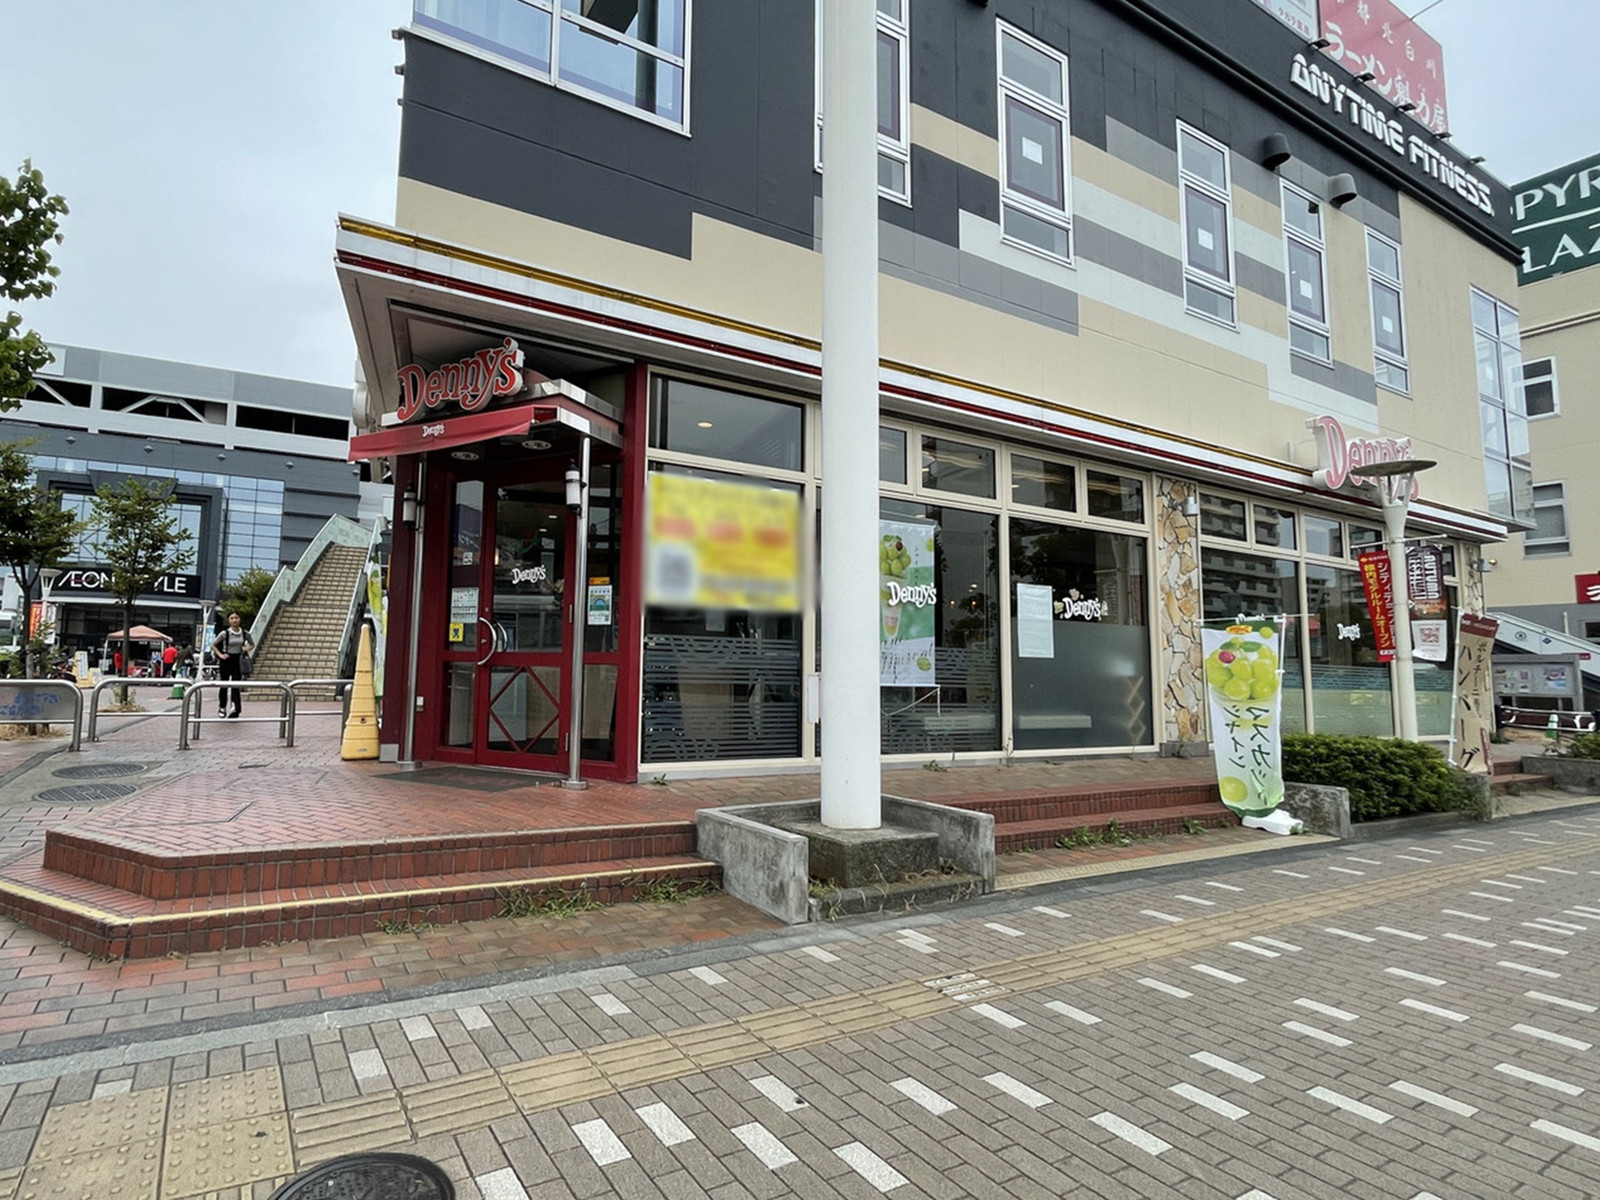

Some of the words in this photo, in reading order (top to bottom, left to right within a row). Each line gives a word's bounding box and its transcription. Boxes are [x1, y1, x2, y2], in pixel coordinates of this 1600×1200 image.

[1336, 0, 1437, 79] 都北白川
[1290, 53, 1404, 155] ANYTIME
[1408, 135, 1494, 216] FITNESS
[1514, 164, 1600, 221] PYR
[397, 336, 522, 423] Denny's
[422, 422, 445, 437] Denny's
[511, 564, 547, 585] Denny's
[886, 580, 938, 608] Denny's
[1408, 556, 1427, 600] FESTIVAL
[1423, 554, 1440, 599] AUTUMN
[1062, 597, 1102, 620] Denny's
[1336, 622, 1361, 641] Denny's
[1457, 644, 1480, 769] ハンバーグ
